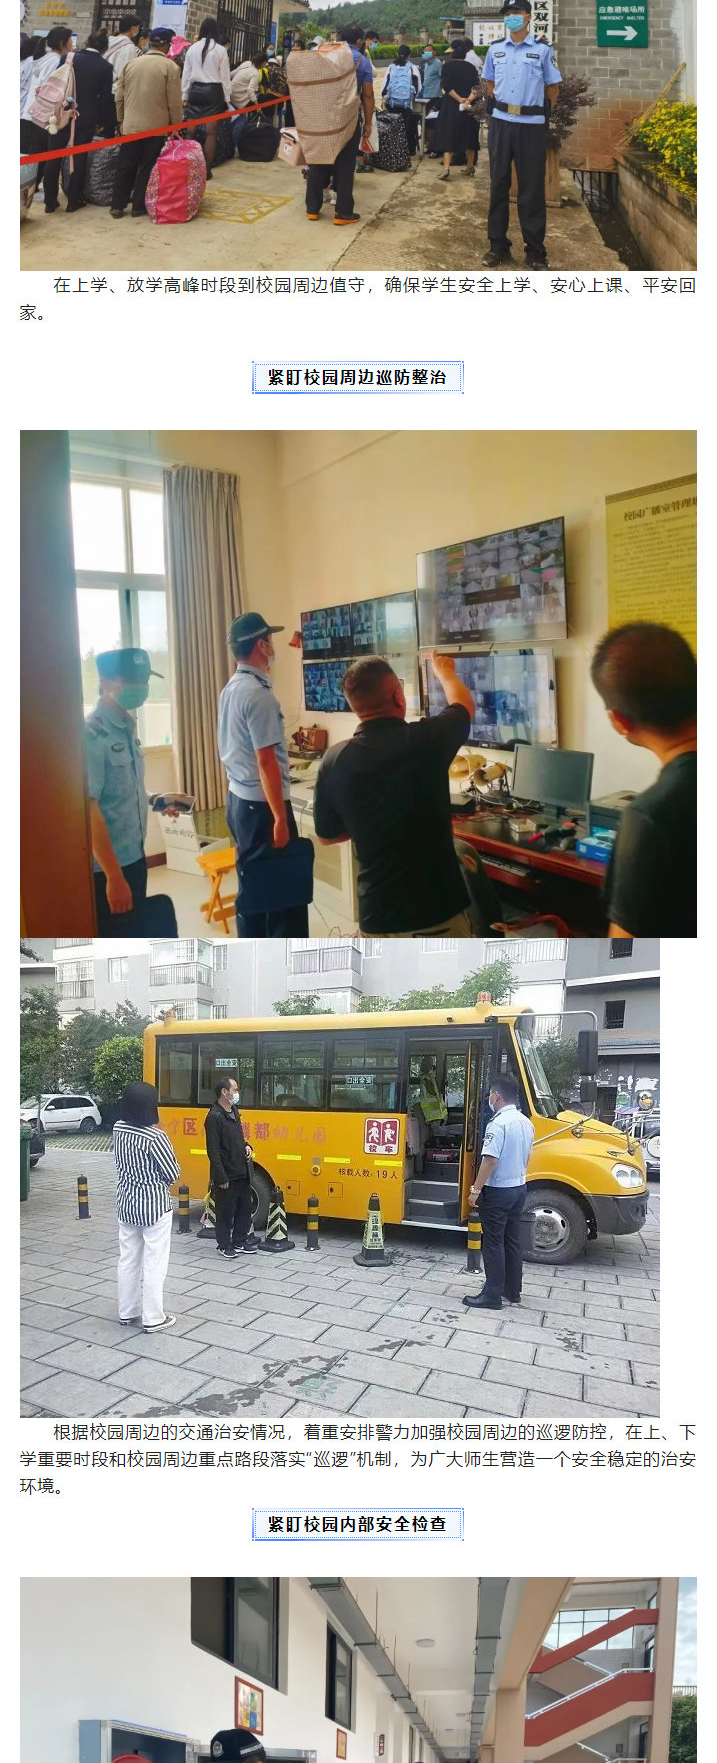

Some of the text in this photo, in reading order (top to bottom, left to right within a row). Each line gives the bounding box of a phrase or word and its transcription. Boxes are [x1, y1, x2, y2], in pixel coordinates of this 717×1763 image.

[598, 5, 645, 14] 应急避难场所
[53, 275, 697, 295] 在上学、放学高峰时段到校园周边值守，确保学生安全上学、安心上课、平安回
[19, 303, 44, 322] 家。
[268, 368, 447, 386] 紧盯校园周边巡防整治
[368, 1144, 394, 1154] 校车
[53, 1422, 697, 1442] 根据校园周边的交通治安情况，着重安排警力加强校园周边的巡逻防控，在上、下
[19, 1477, 61, 1496] 环境。
[268, 1515, 446, 1533] 紧盯校园内部安全检查
